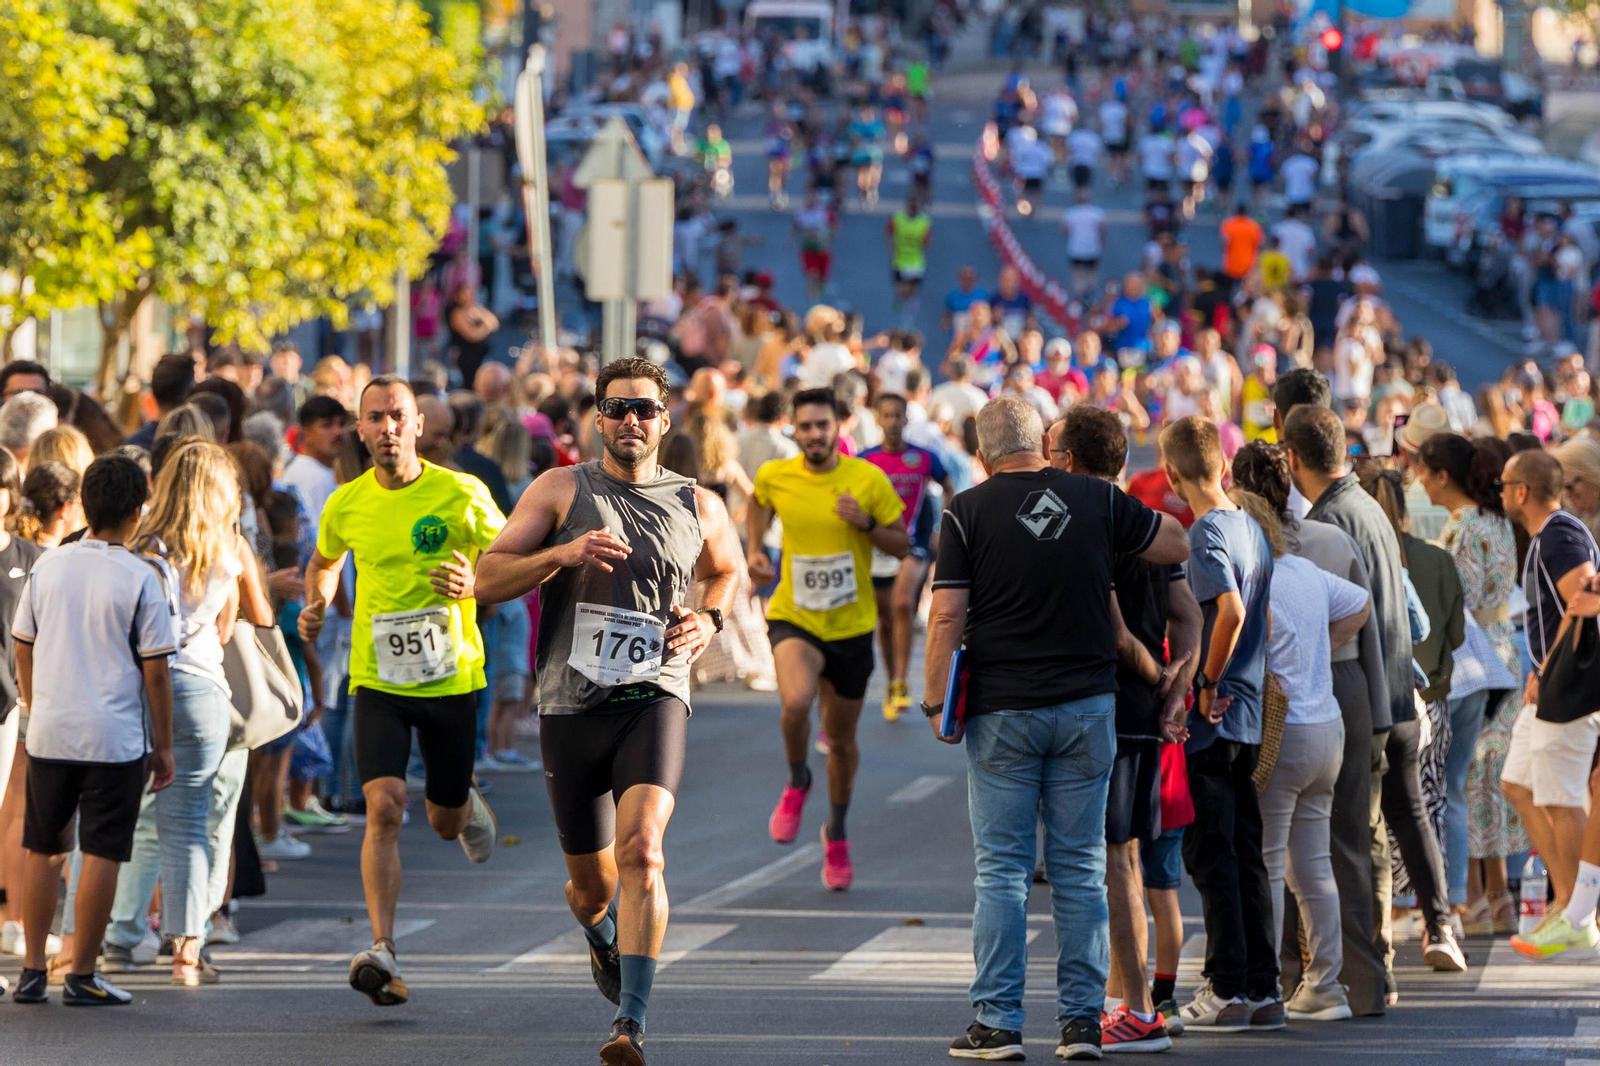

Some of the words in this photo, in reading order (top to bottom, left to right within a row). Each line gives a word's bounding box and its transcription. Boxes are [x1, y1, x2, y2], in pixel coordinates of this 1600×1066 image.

[804, 569, 843, 590] 699
[389, 628, 435, 656] 951
[592, 629, 647, 663] 176
